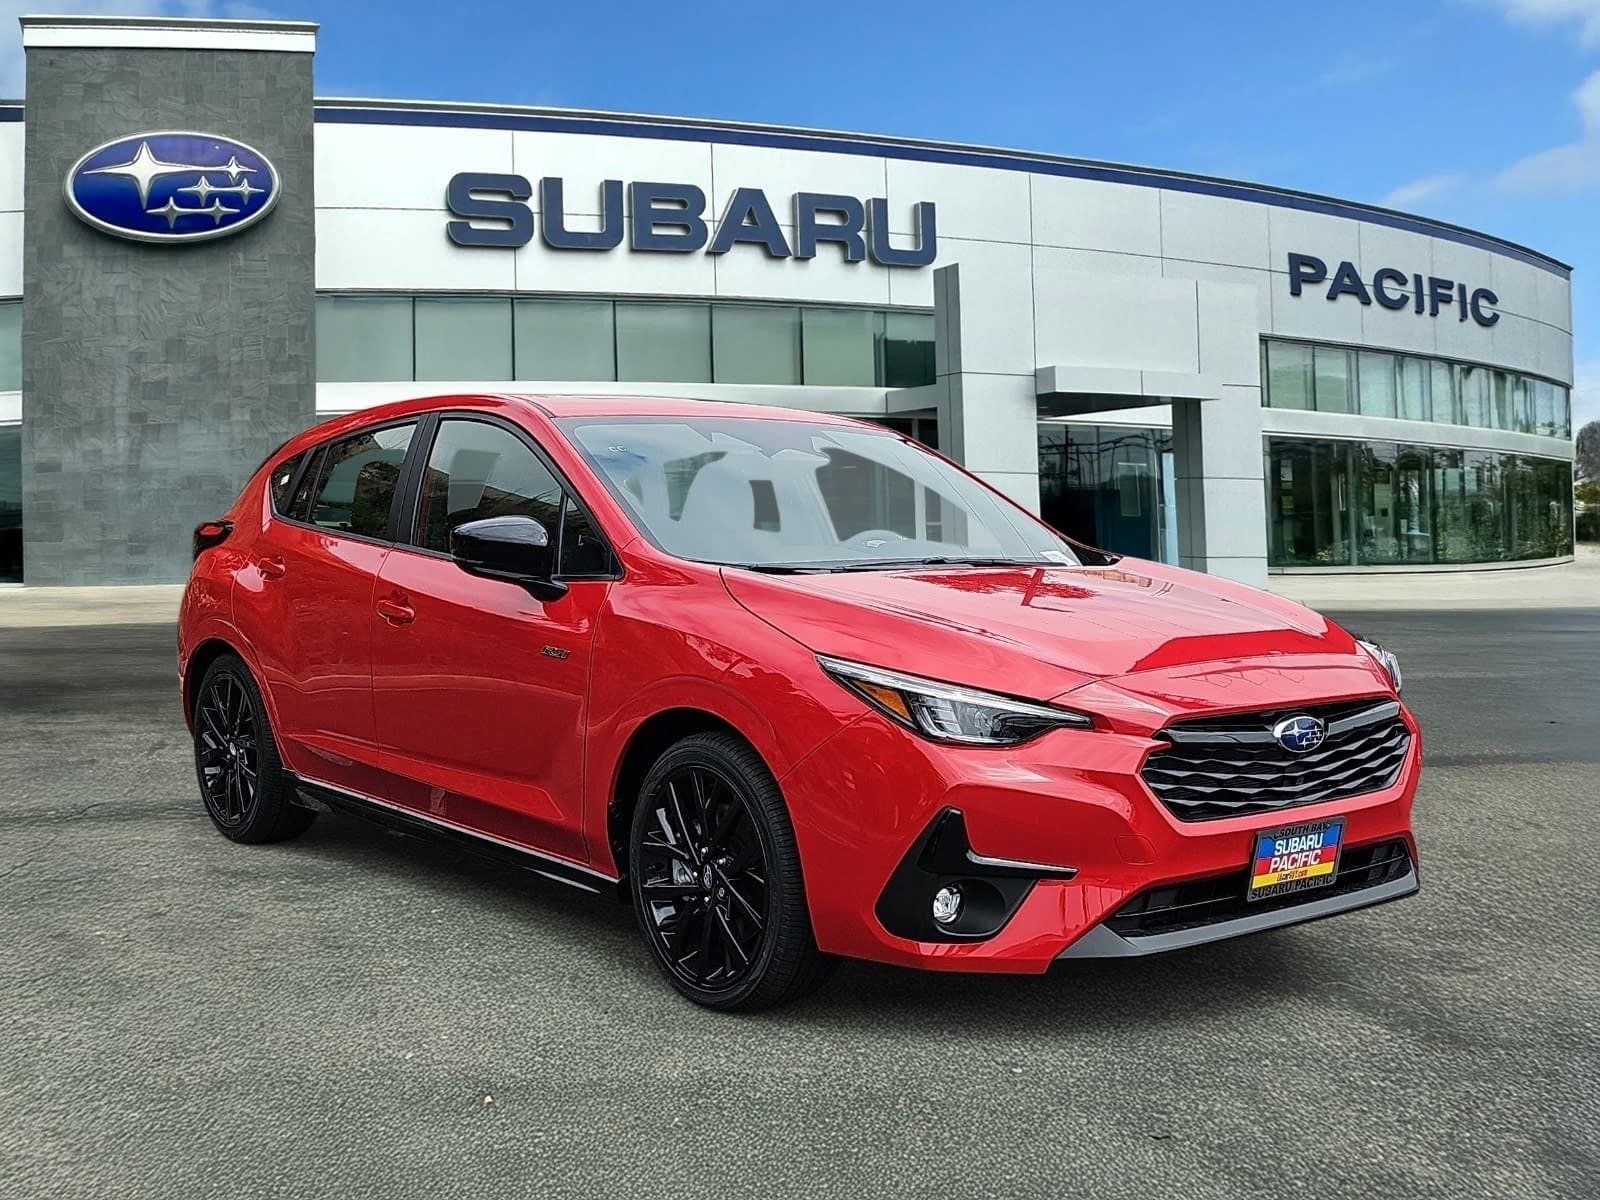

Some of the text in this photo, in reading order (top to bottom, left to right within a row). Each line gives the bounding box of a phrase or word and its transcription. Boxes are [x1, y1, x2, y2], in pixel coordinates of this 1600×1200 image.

[446, 172, 937, 268] SUBARU
[1287, 252, 1500, 327] PACIFIC
[1280, 825, 1309, 837] SOUTH
[1274, 833, 1323, 856] SUBARU
[1269, 850, 1321, 873] PACIFIC
[1251, 881, 1292, 899] SUBARU
[1295, 874, 1332, 890] PACIFIC
